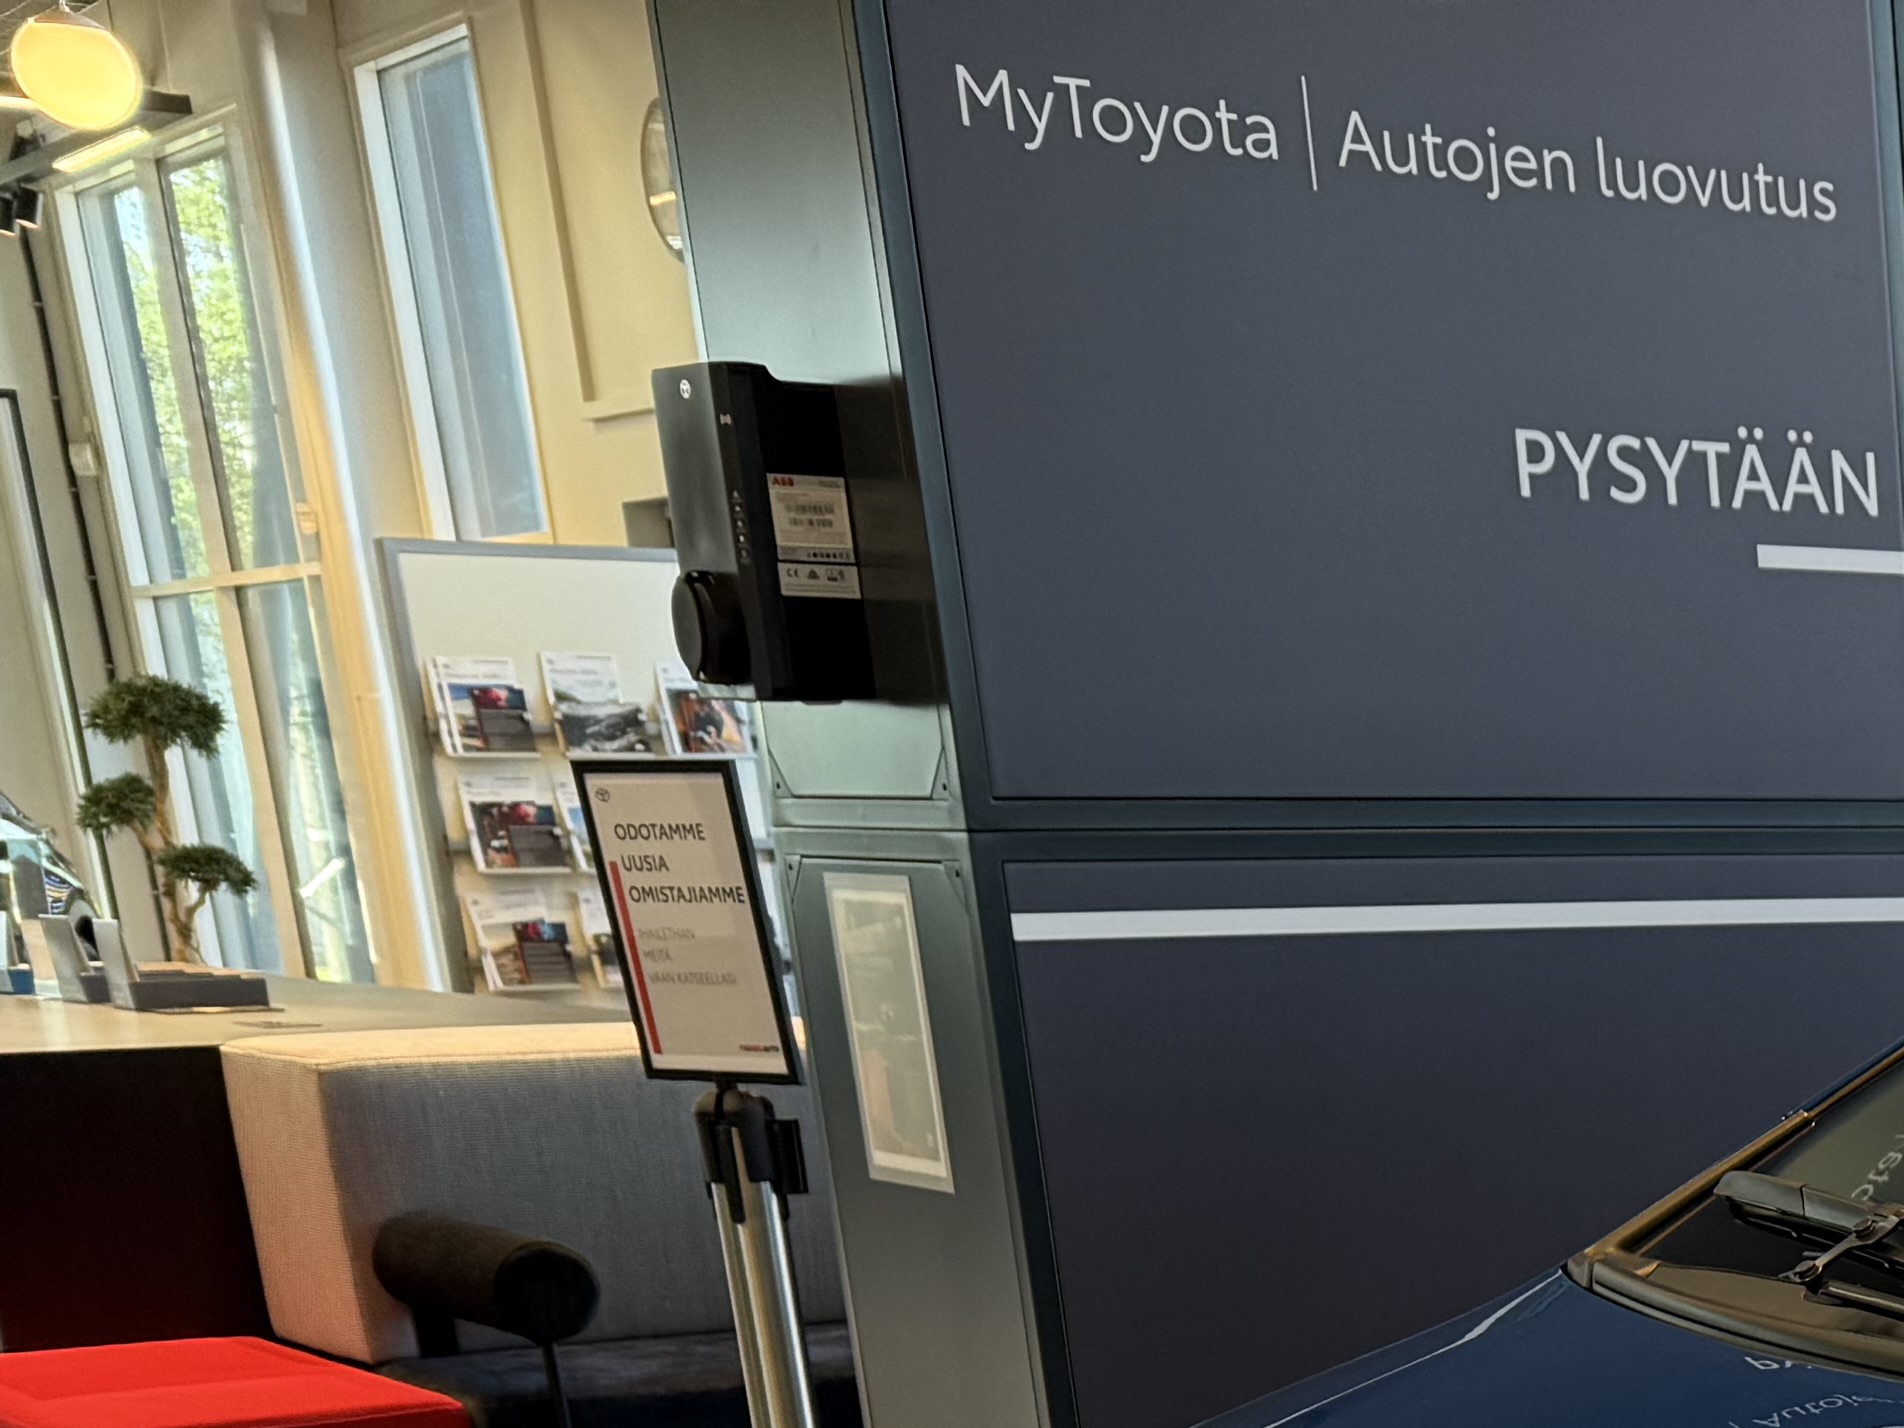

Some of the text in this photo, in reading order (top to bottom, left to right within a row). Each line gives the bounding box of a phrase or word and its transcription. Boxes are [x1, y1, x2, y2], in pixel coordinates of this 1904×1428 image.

[954, 64, 1838, 223] MyToyota Autojen luovutus
[1514, 426, 1880, 519] PYSYTÄÄN
[613, 823, 706, 841] ODOTAMME
[620, 854, 669, 873] UUSIA
[628, 885, 746, 905] OMISTAJIAMME
